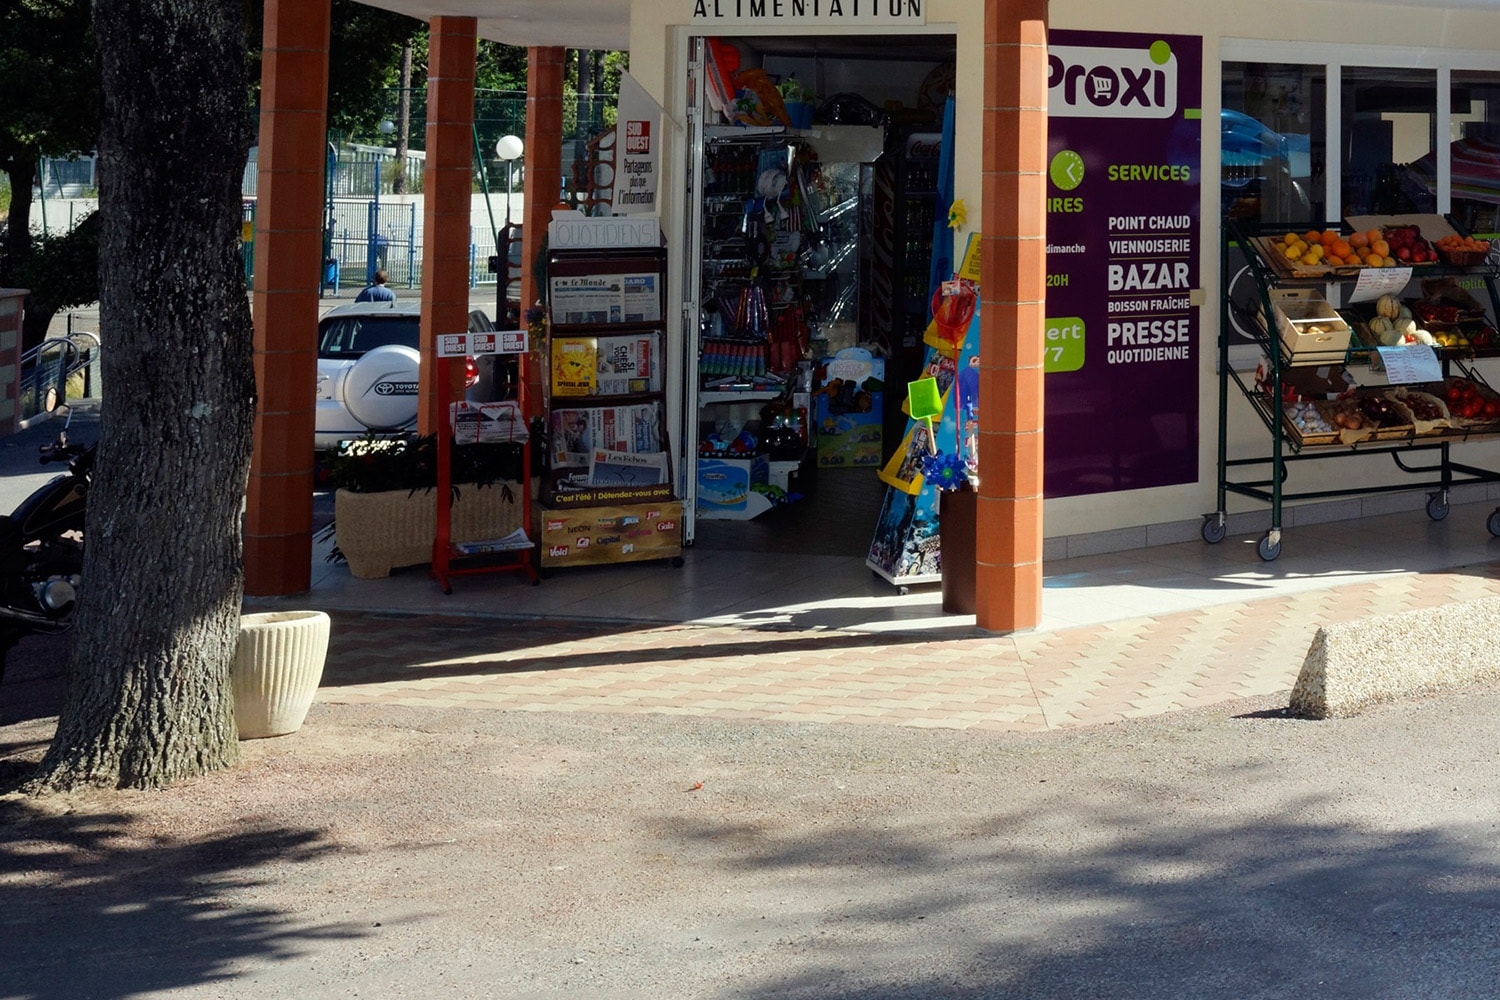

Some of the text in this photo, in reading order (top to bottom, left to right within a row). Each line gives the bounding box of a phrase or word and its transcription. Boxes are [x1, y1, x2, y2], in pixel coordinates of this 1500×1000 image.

[1048, 40, 1171, 108] Proxi
[627, 122, 642, 136] SUD
[627, 136, 649, 150] OUEST
[624, 159, 652, 176] Partageons
[1108, 165, 1190, 181] SERVICES
[618, 189, 654, 204] l'information
[1048, 198, 1084, 213] IRES
[1109, 216, 1190, 230] POINT CHAUD
[557, 224, 652, 246] QUOTIDIENS
[1046, 244, 1086, 253] dimanche
[1109, 239, 1190, 254] VIENNOISERIE
[1047, 274, 1069, 286] 20H
[1108, 262, 1190, 291] BAZAR
[1108, 296, 1190, 312] BOISSON FRAÎCHE
[474, 335, 487, 343] SUD
[503, 334, 517, 342] SUD
[1047, 324, 1081, 341] ert
[1107, 319, 1190, 346] PRESSE
[445, 336, 458, 344] SUD
[474, 343, 495, 351] OUEST
[503, 341, 524, 349] OUEST
[445, 344, 465, 352] OUEST
[1107, 346, 1189, 364] QUOTIDIENNE
[556, 495, 574, 503] C'est
[598, 490, 652, 500] Détendez-vous
[567, 525, 591, 534] NEON
[596, 536, 621, 545] Capital
